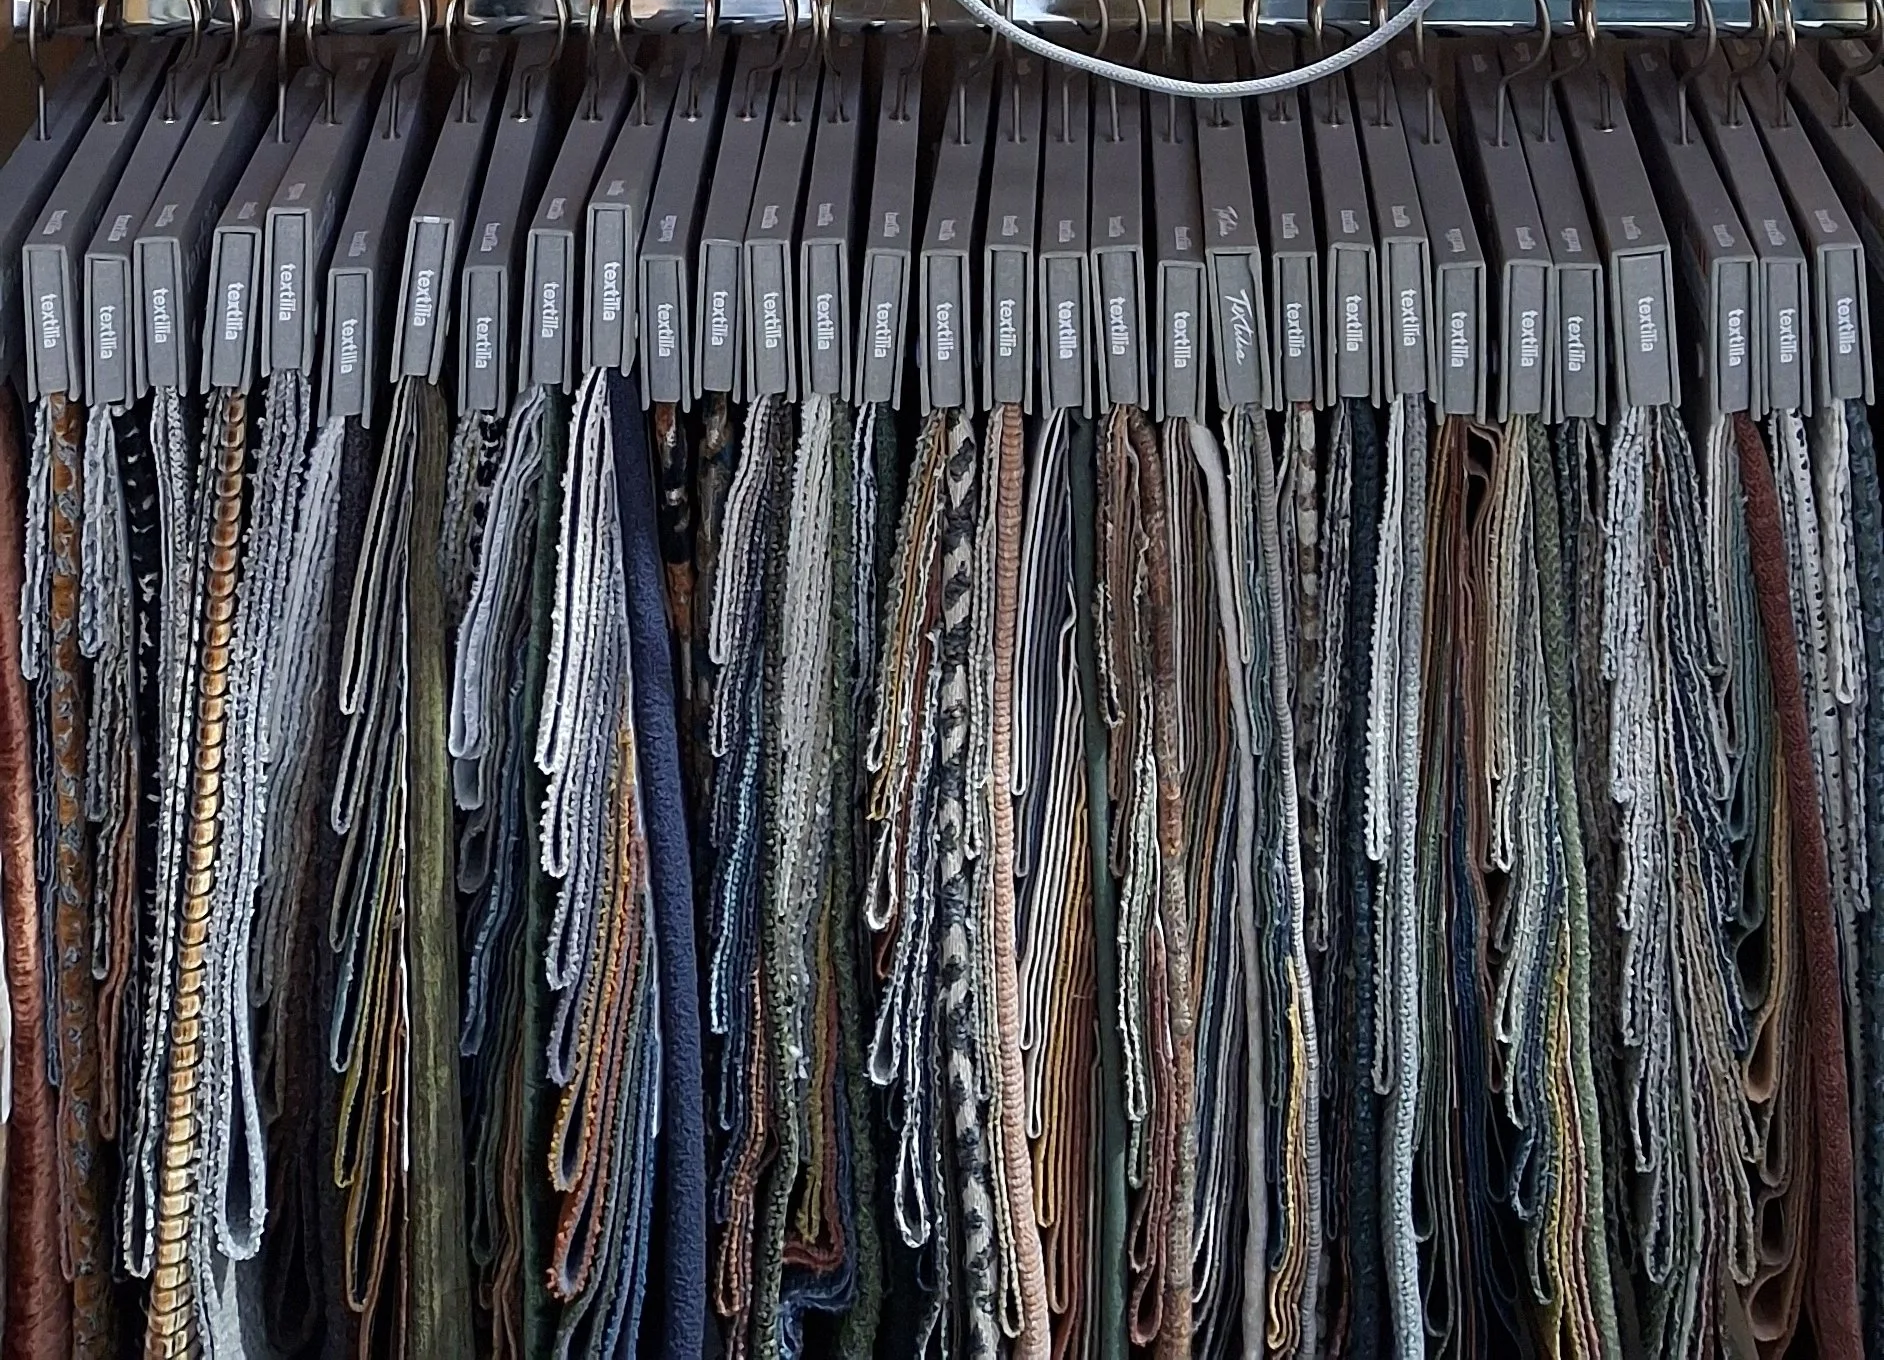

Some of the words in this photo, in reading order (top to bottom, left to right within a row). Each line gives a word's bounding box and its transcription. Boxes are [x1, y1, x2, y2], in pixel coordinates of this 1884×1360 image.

[152, 287, 171, 343] textilia
[225, 282, 245, 340] textilia
[278, 263, 297, 321] textilia
[413, 269, 435, 327] textilia
[541, 283, 560, 338] textilia
[602, 261, 621, 321] textilia
[711, 291, 729, 346] textilia
[1400, 288, 1421, 347] textilia
[40, 293, 61, 349] textilia
[99, 305, 117, 359] textilia
[340, 318, 358, 374] textilia
[475, 317, 493, 369] textilia
[657, 303, 675, 357] textilia
[763, 291, 782, 349] textilia
[816, 293, 835, 350] textilia
[874, 301, 893, 358] textilia
[936, 302, 954, 361] textilia
[999, 299, 1017, 357] textilia
[1058, 300, 1077, 359] textilia
[1109, 296, 1127, 356] textilia
[1173, 311, 1192, 368] textilia
[1286, 302, 1306, 357] textilia
[1345, 294, 1364, 352] textilia
[1451, 311, 1469, 368] textilia
[1521, 310, 1539, 367] textilia
[1567, 316, 1586, 372] textilia
[1638, 296, 1658, 352] textilia
[1728, 308, 1745, 367] textilia
[1779, 308, 1798, 363] textilia
[1837, 297, 1856, 354] textilia
